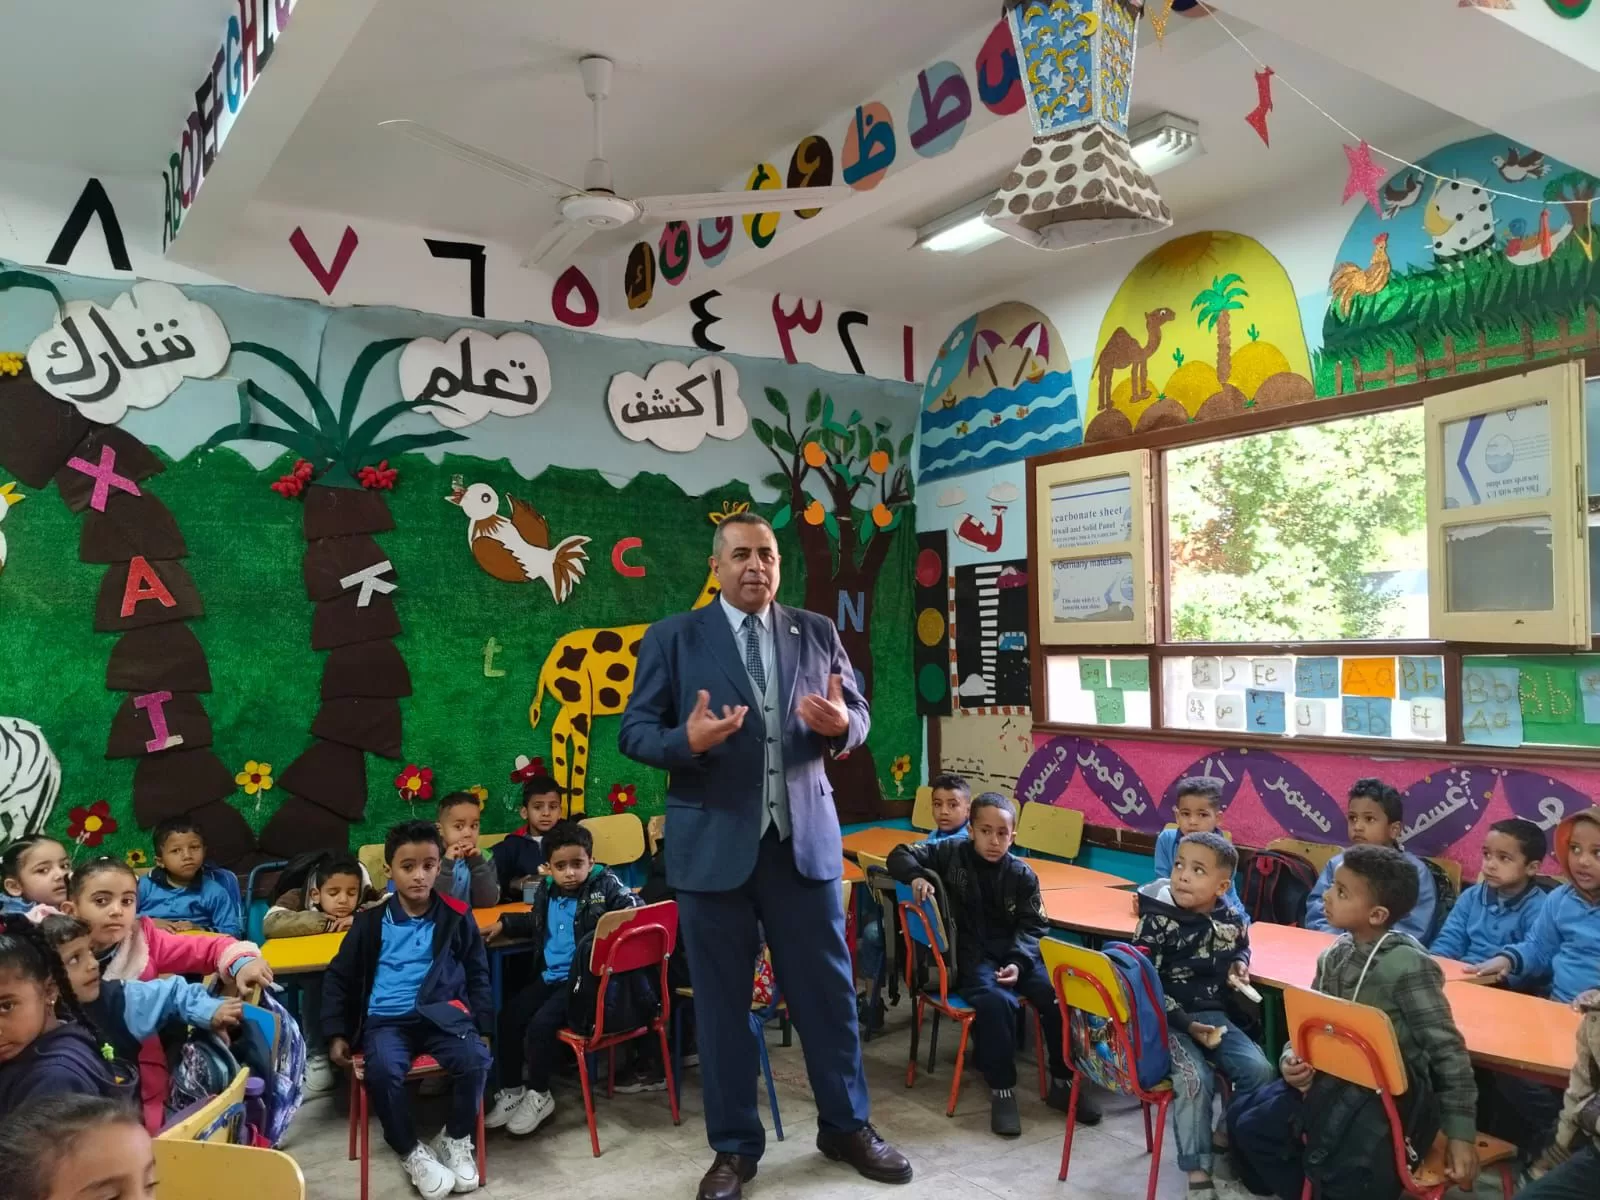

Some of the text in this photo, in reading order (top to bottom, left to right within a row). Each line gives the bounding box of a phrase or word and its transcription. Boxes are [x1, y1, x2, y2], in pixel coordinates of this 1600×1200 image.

[45, 177, 132, 271] ٨
[288, 225, 359, 296] ٧
[424, 238, 486, 318] ٦
[690, 289, 726, 352] ٤
[772, 292, 823, 364] ٣
[837, 310, 868, 374] ٢
[413, 336, 538, 405] تعلم
[621, 368, 725, 426] اكتشف
[1051, 511, 1097, 524] carbonate
[120, 556, 176, 617] A
[340, 561, 397, 607] K
[1057, 560, 1088, 570] Germany
[1089, 556, 1123, 568] materials
[837, 590, 864, 633] N
[1255, 664, 1277, 686] Ee
[1402, 659, 1439, 694] Bb
[1263, 775, 1332, 833] سبتمبر
